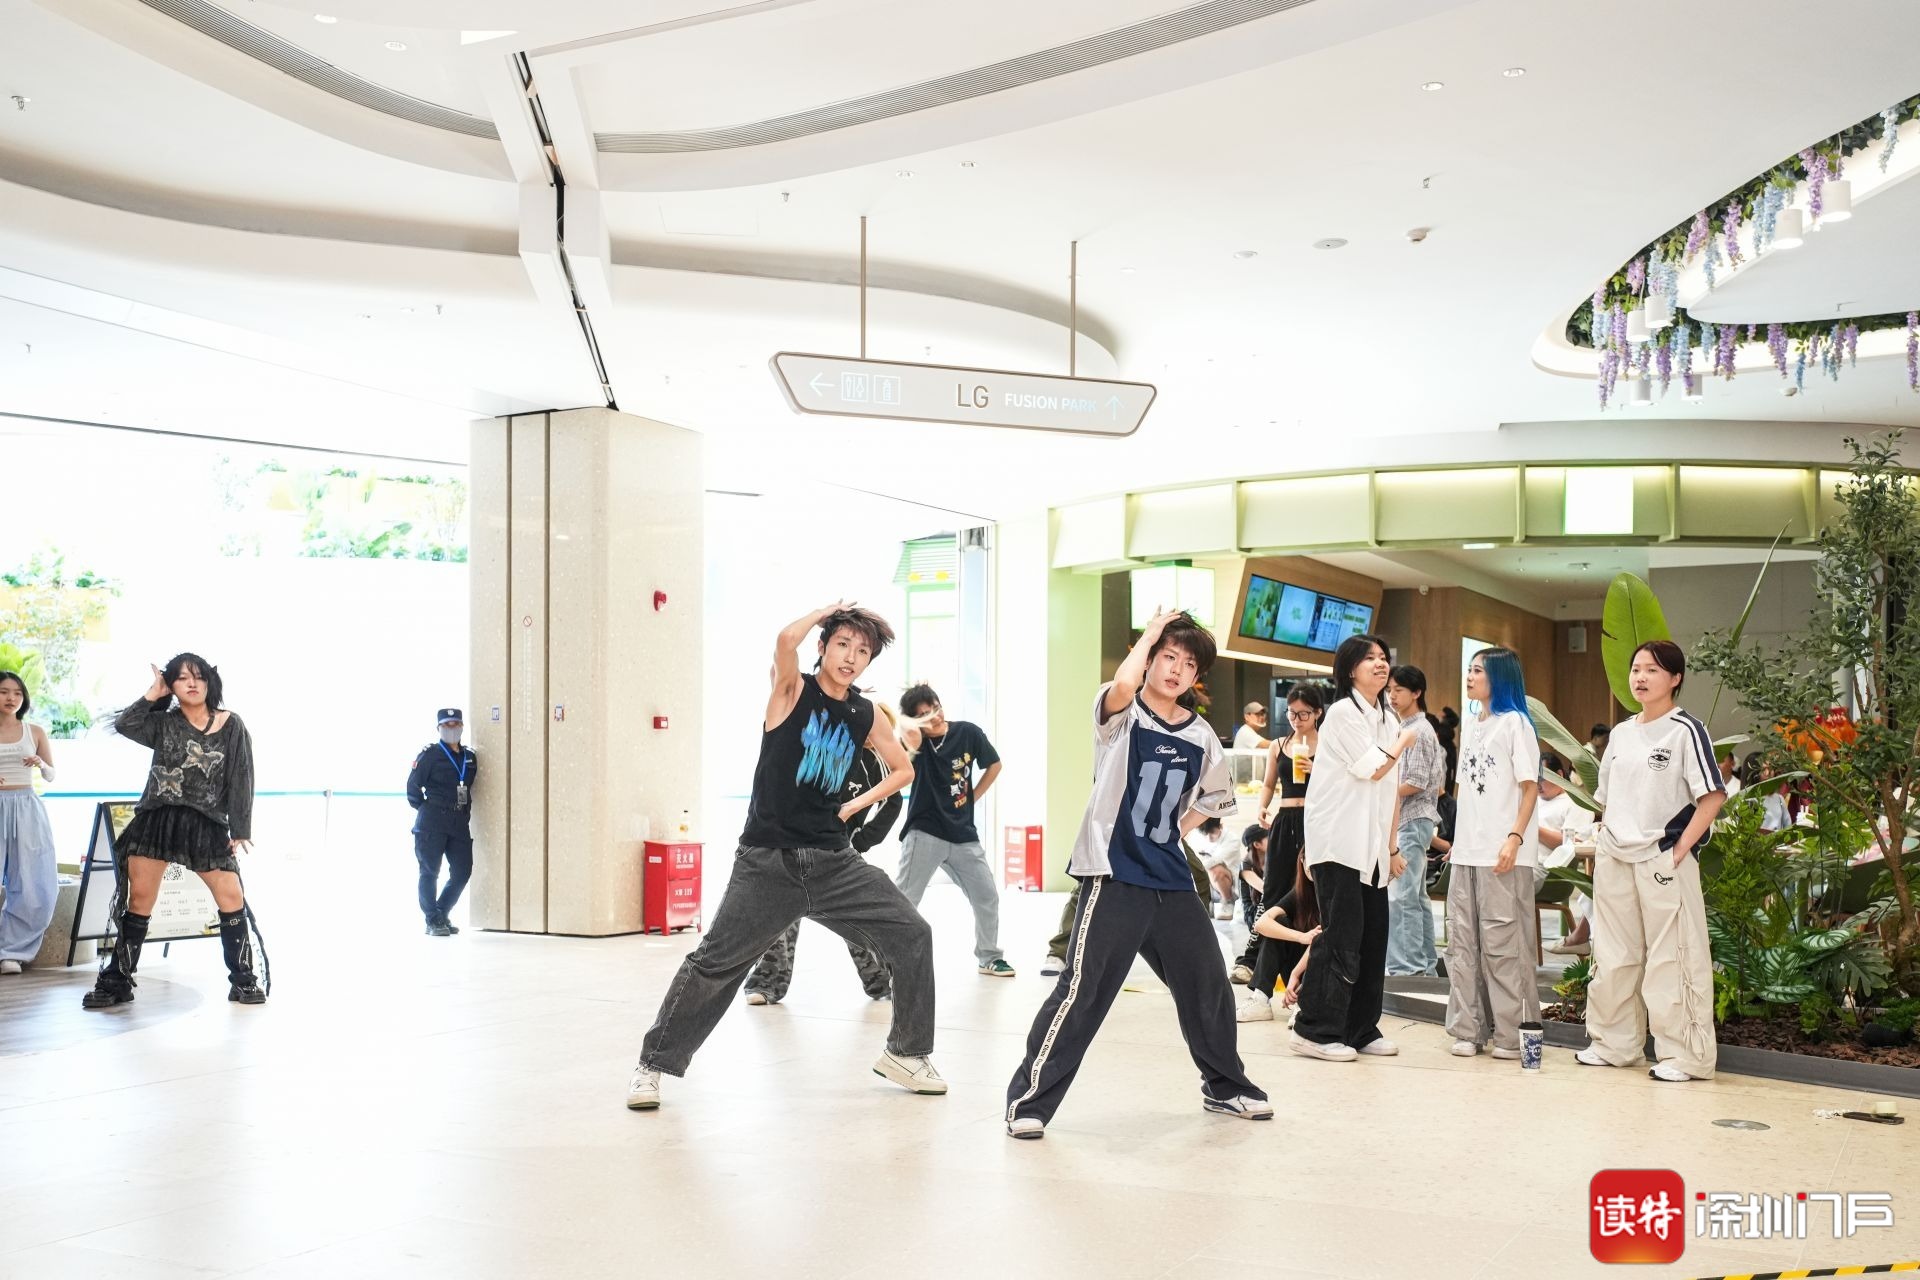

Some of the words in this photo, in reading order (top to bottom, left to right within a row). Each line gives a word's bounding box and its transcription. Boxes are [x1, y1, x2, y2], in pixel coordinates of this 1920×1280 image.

[957, 383, 989, 409] LG
[1004, 392, 1057, 410] FUSION
[1060, 398, 1097, 412] PARK
[1131, 761, 1187, 844] 11
